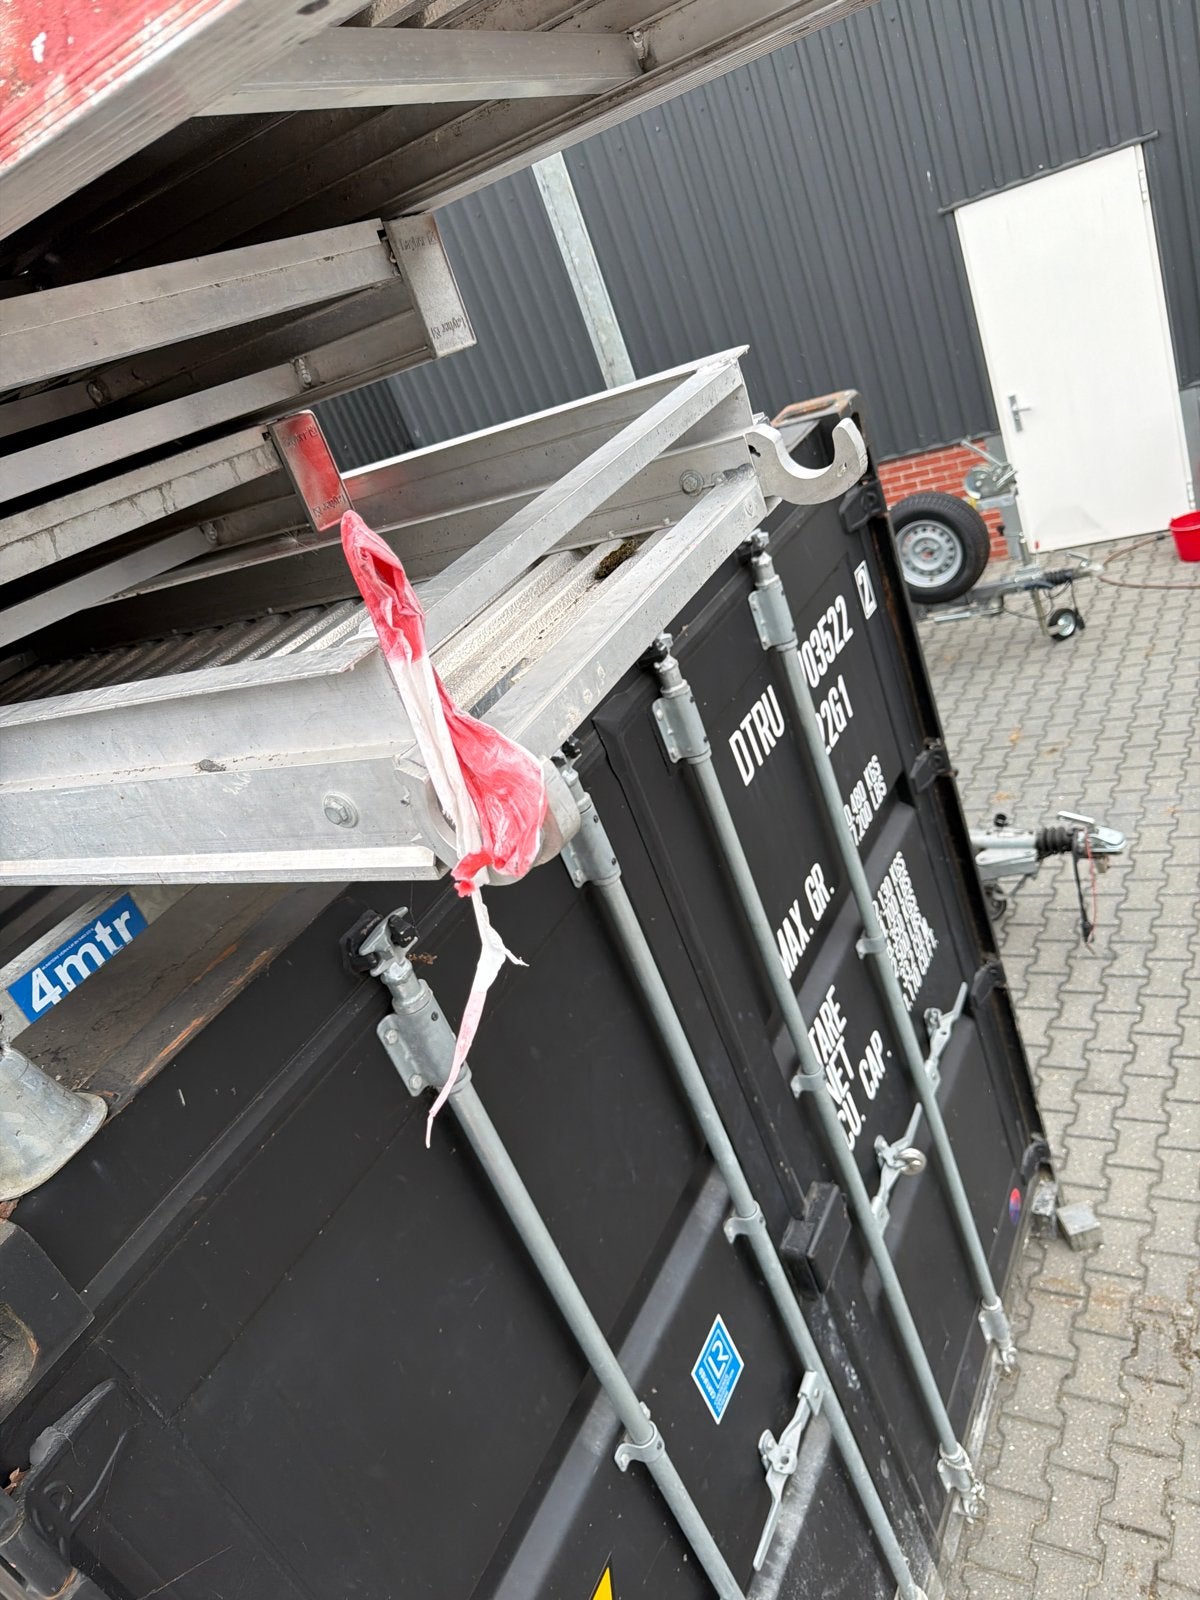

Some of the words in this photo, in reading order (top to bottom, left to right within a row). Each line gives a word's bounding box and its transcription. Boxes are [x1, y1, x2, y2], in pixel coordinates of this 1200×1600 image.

[728, 684, 785, 787] DTRU
[797, 595, 854, 688] 03522
[857, 568, 874, 614] 2
[850, 800, 873, 847] 7.200
[869, 775, 887, 811] LBS
[777, 899, 814, 979] MAX.
[804, 863, 835, 921] GR.
[843, 780, 868, 828] 0.480
[863, 754, 881, 791] KGS
[895, 869, 912, 905] LBS
[32, 910, 133, 1013] 4mtr
[808, 984, 847, 1064] TARE
[889, 851, 906, 887] KGS
[826, 1035, 854, 1105] NET
[901, 888, 917, 923] KGS
[859, 1030, 892, 1100] CAP.
[708, 1340, 730, 1379] LR
